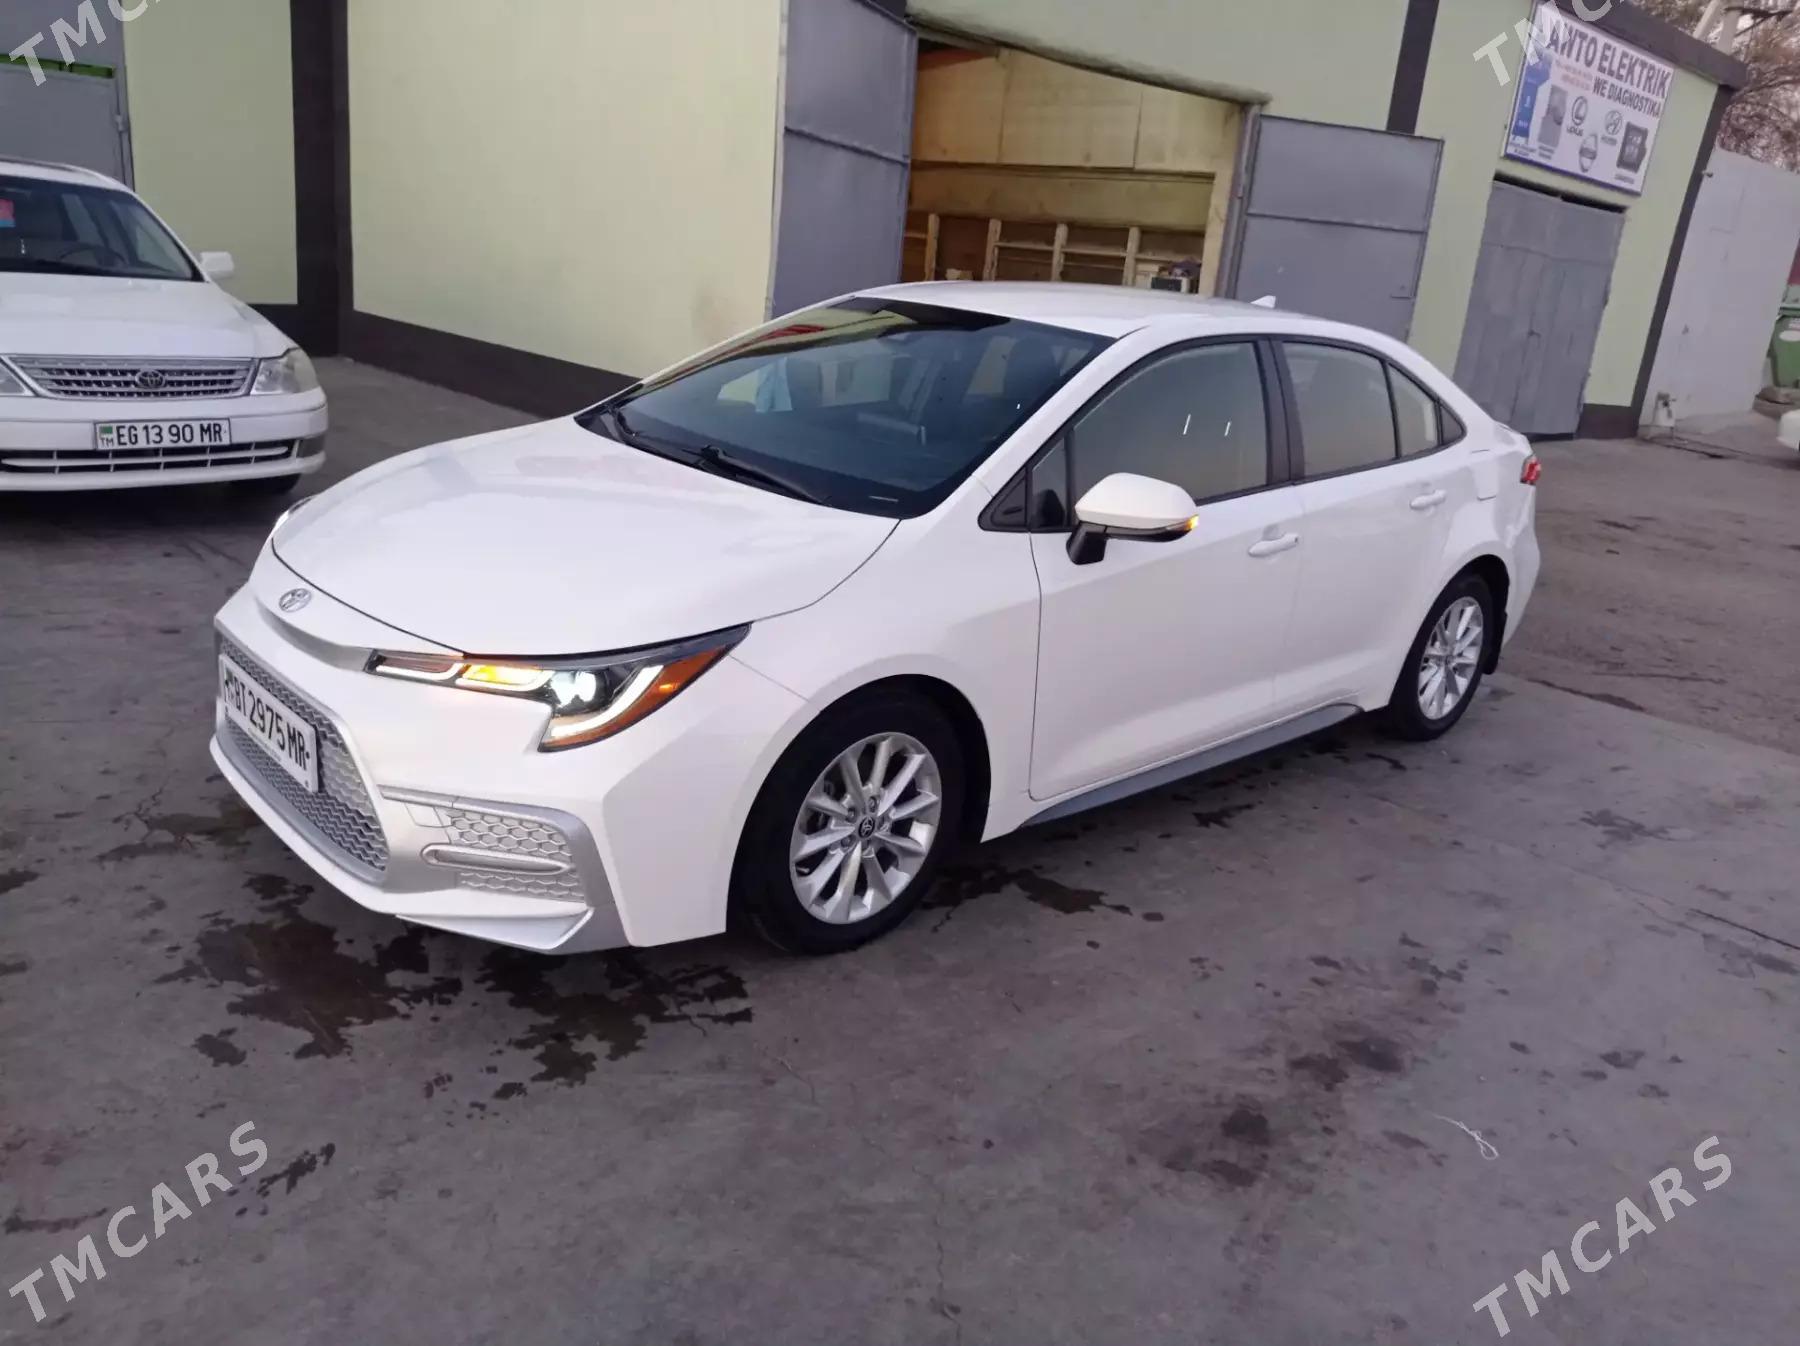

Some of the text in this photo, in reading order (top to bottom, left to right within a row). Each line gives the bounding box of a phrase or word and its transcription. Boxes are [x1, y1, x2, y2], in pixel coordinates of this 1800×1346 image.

[1597, 41, 1671, 99] ELEKTRIK
[1592, 76, 1661, 117] WE DIAGNOSTIKA
[101, 437, 114, 447] TM
[115, 425, 139, 446] EG
[199, 422, 223, 443] MR
[286, 721, 307, 771] MR
